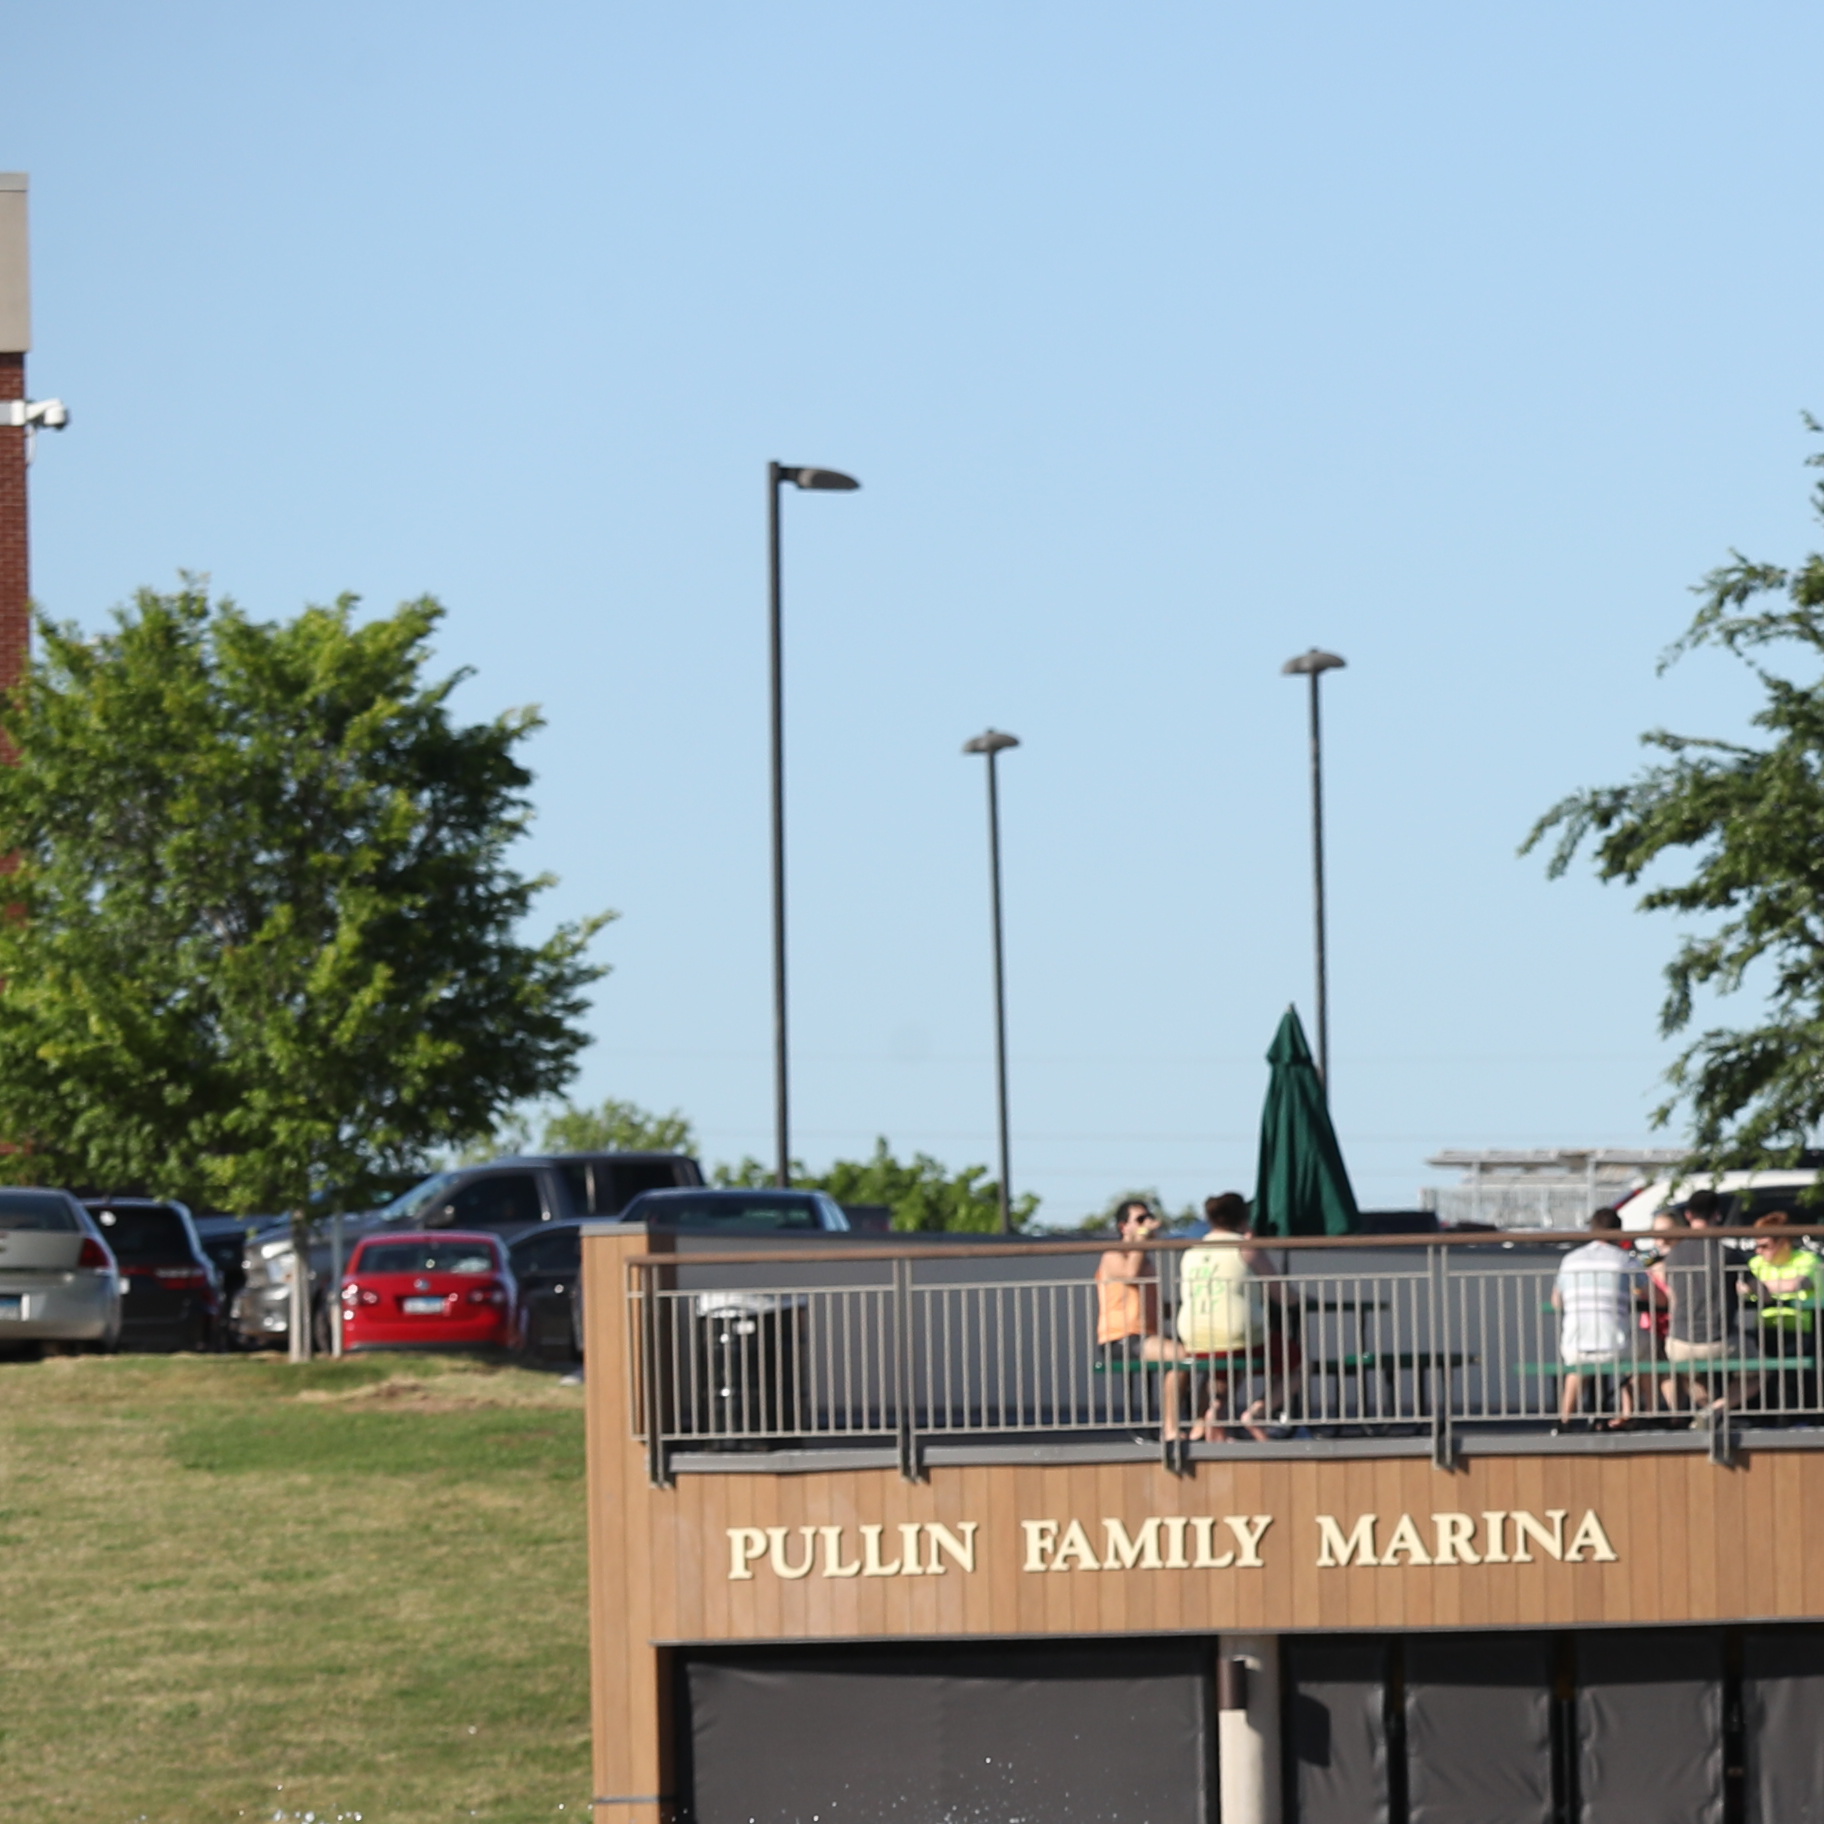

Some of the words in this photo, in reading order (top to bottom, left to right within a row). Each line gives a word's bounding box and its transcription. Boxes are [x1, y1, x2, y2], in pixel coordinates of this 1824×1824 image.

[725, 1521, 978, 1581] PULLIN
[1020, 1513, 1272, 1573] FAMILY
[1315, 1507, 1618, 1567] MARINA
